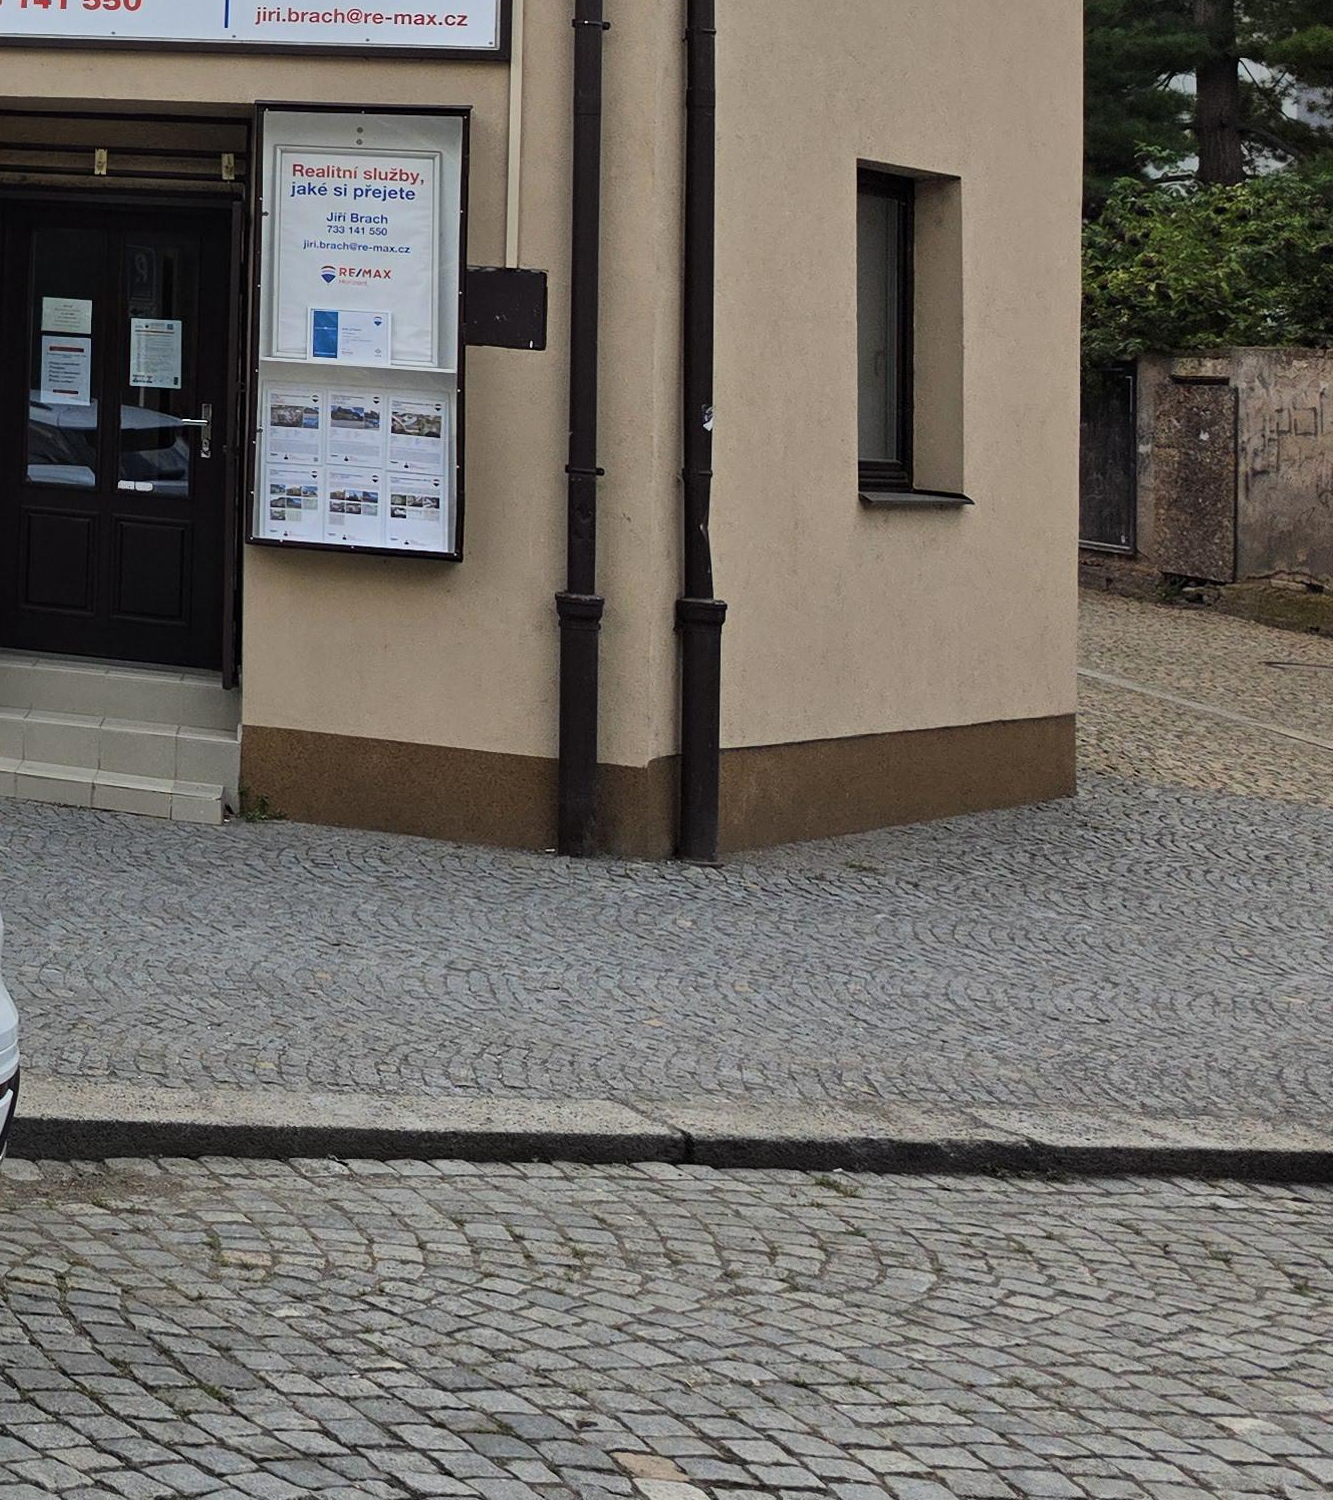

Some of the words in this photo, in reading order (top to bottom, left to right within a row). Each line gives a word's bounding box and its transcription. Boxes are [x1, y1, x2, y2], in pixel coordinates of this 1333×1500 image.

[255, 7, 468, 26] jiri.brach@re-max.cz
[293, 164, 358, 179] Realitní
[364, 168, 424, 185] služby,
[291, 182, 328, 197] jaké
[334, 184, 347, 197] si
[354, 185, 415, 201] přejete
[326, 212, 346, 222] Jiří
[351, 213, 388, 224] Brach
[327, 225, 345, 234] 733
[369, 227, 388, 235] 550
[303, 240, 410, 254] jiri.brach@re-max.cz
[339, 268, 391, 279] RE/MAX
